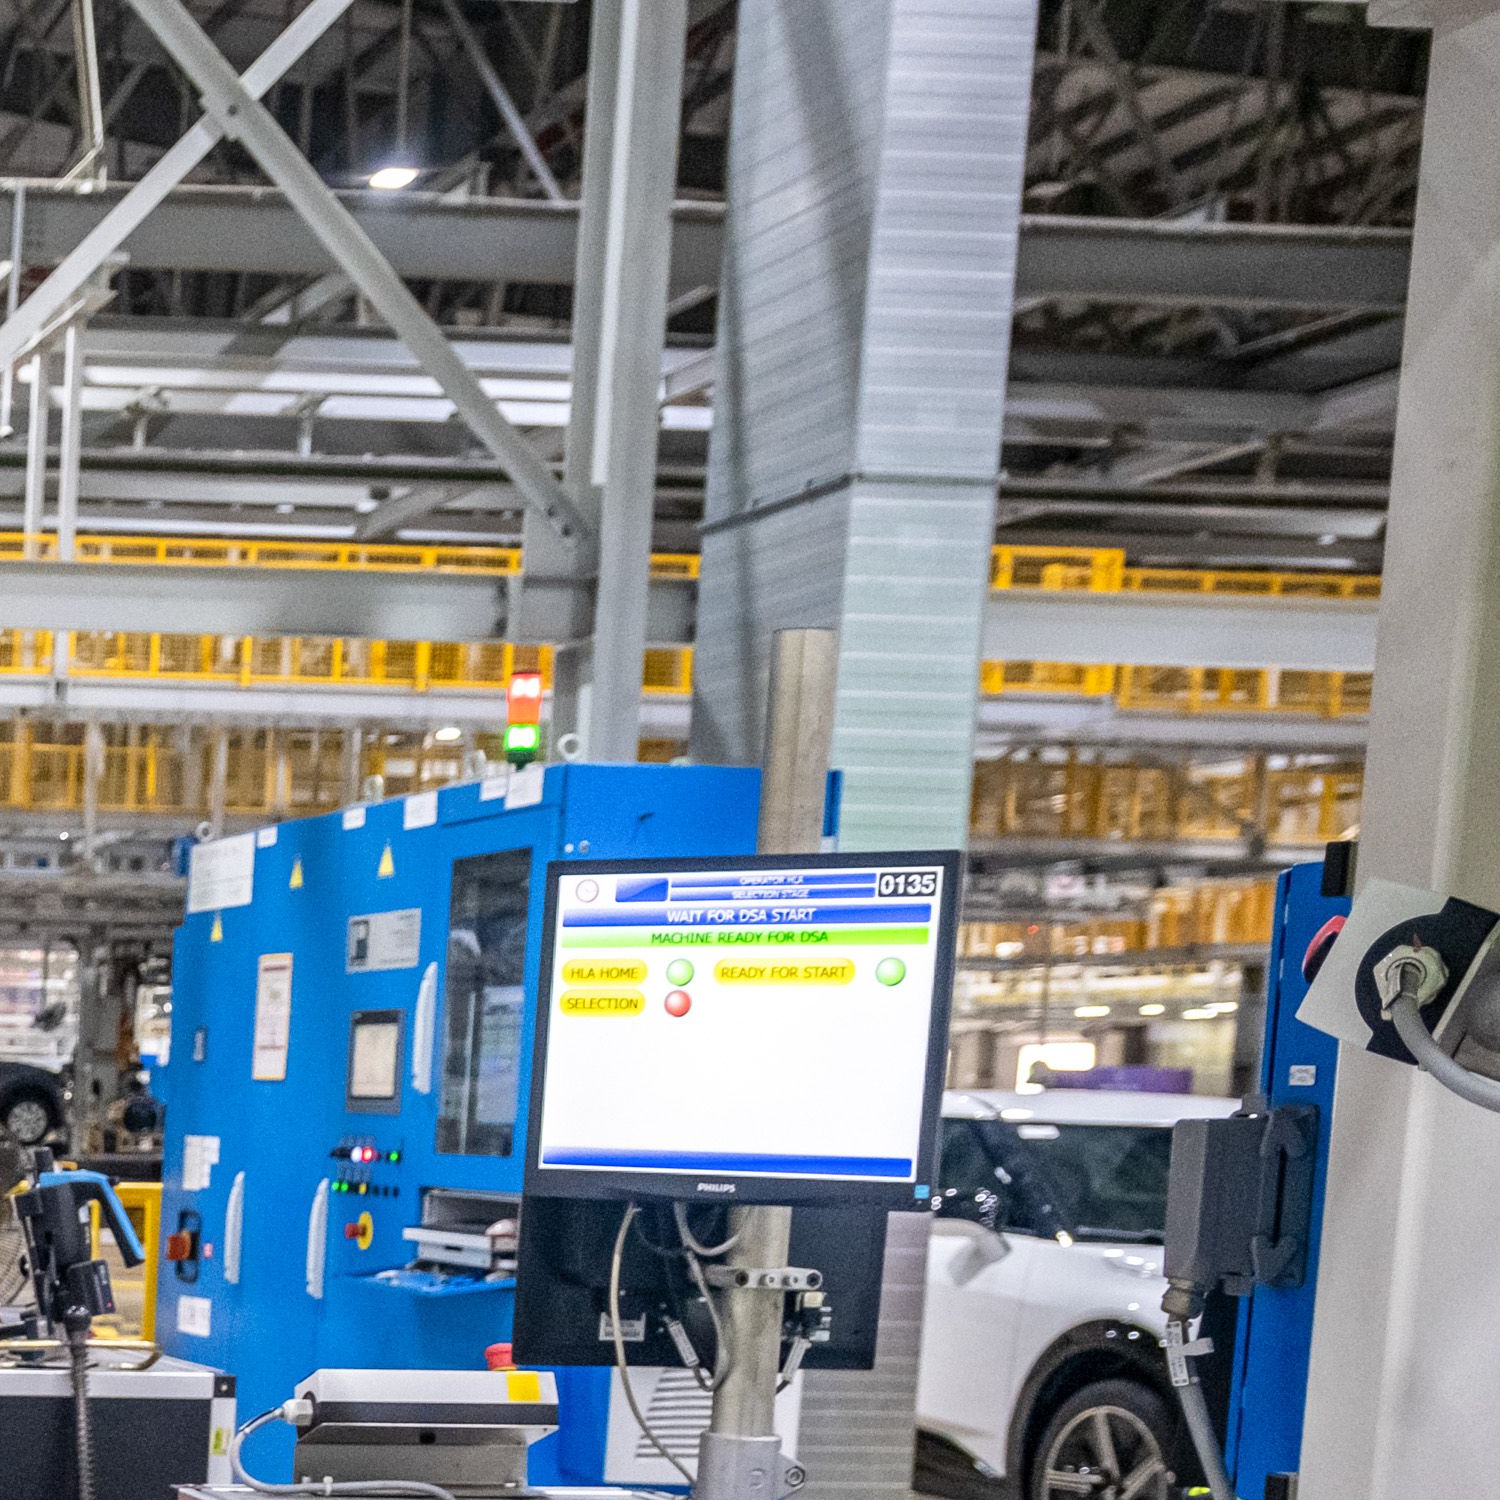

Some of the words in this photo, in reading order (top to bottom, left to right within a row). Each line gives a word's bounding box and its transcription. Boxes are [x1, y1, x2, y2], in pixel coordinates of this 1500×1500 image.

[880, 874, 936, 896] 0135
[666, 909, 704, 923] WAIT
[707, 909, 735, 922] FOR
[739, 909, 767, 922] DSA
[771, 908, 817, 921] START
[651, 932, 712, 944] MACHINE
[717, 932, 763, 943] READY
[767, 931, 795, 943] FOR
[800, 931, 829, 942] DSA
[570, 967, 596, 979] HLA
[600, 967, 639, 979] HOME
[721, 967, 766, 979] READY
[771, 967, 799, 979] FOR
[803, 966, 847, 979] START
[567, 998, 639, 1010] SELECTION
[696, 1182, 736, 1193] PHILIPS
